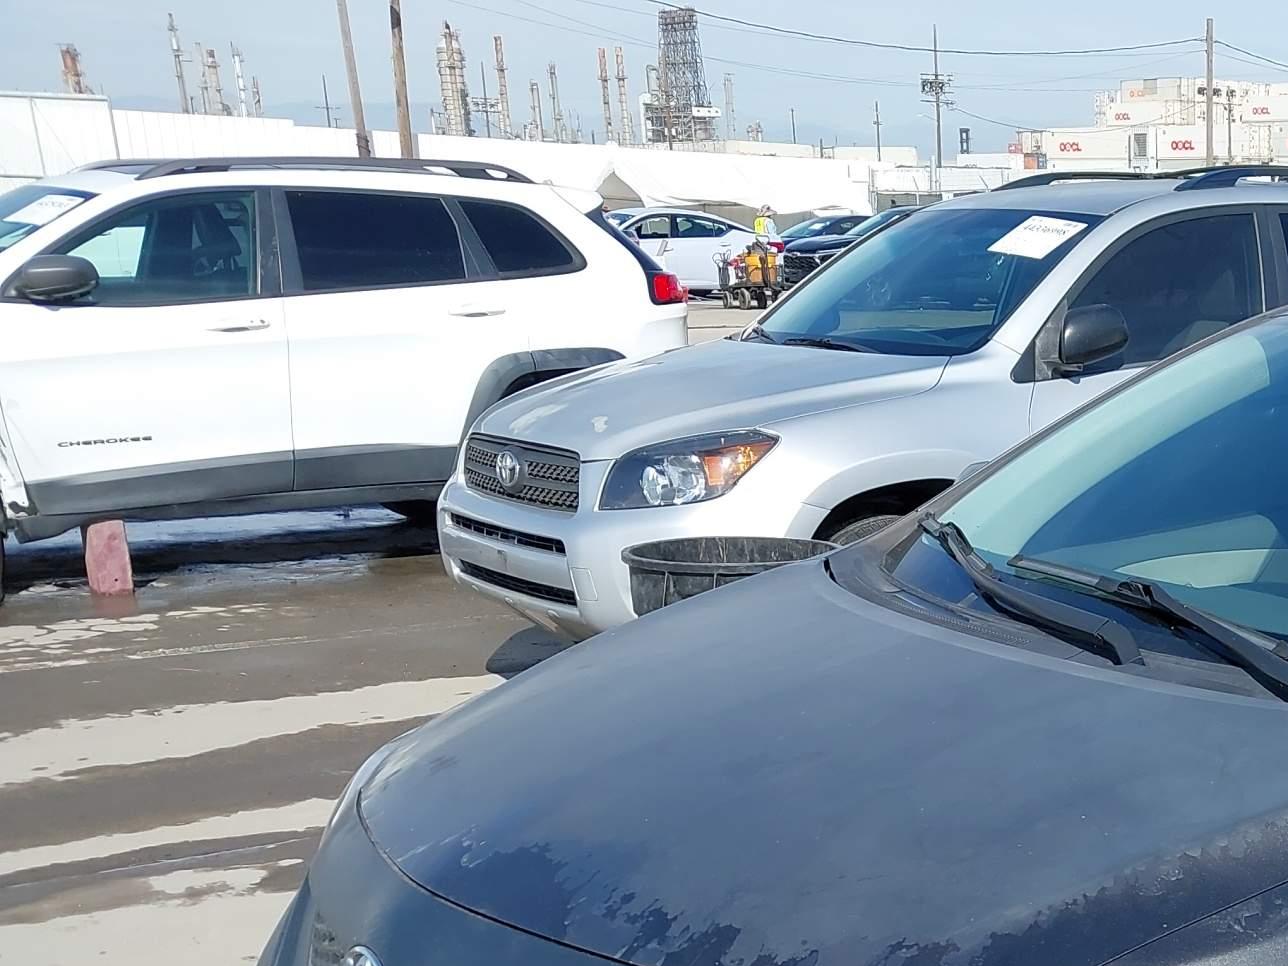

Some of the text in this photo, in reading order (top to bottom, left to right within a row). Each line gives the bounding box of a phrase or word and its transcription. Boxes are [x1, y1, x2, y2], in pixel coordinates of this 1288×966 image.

[1252, 107, 1270, 115] OOCL
[1115, 113, 1131, 121] OOCL
[1059, 142, 1082, 152] OOCL
[1171, 140, 1195, 151] OOCL
[57, 436, 153, 447] CHEROKEE
